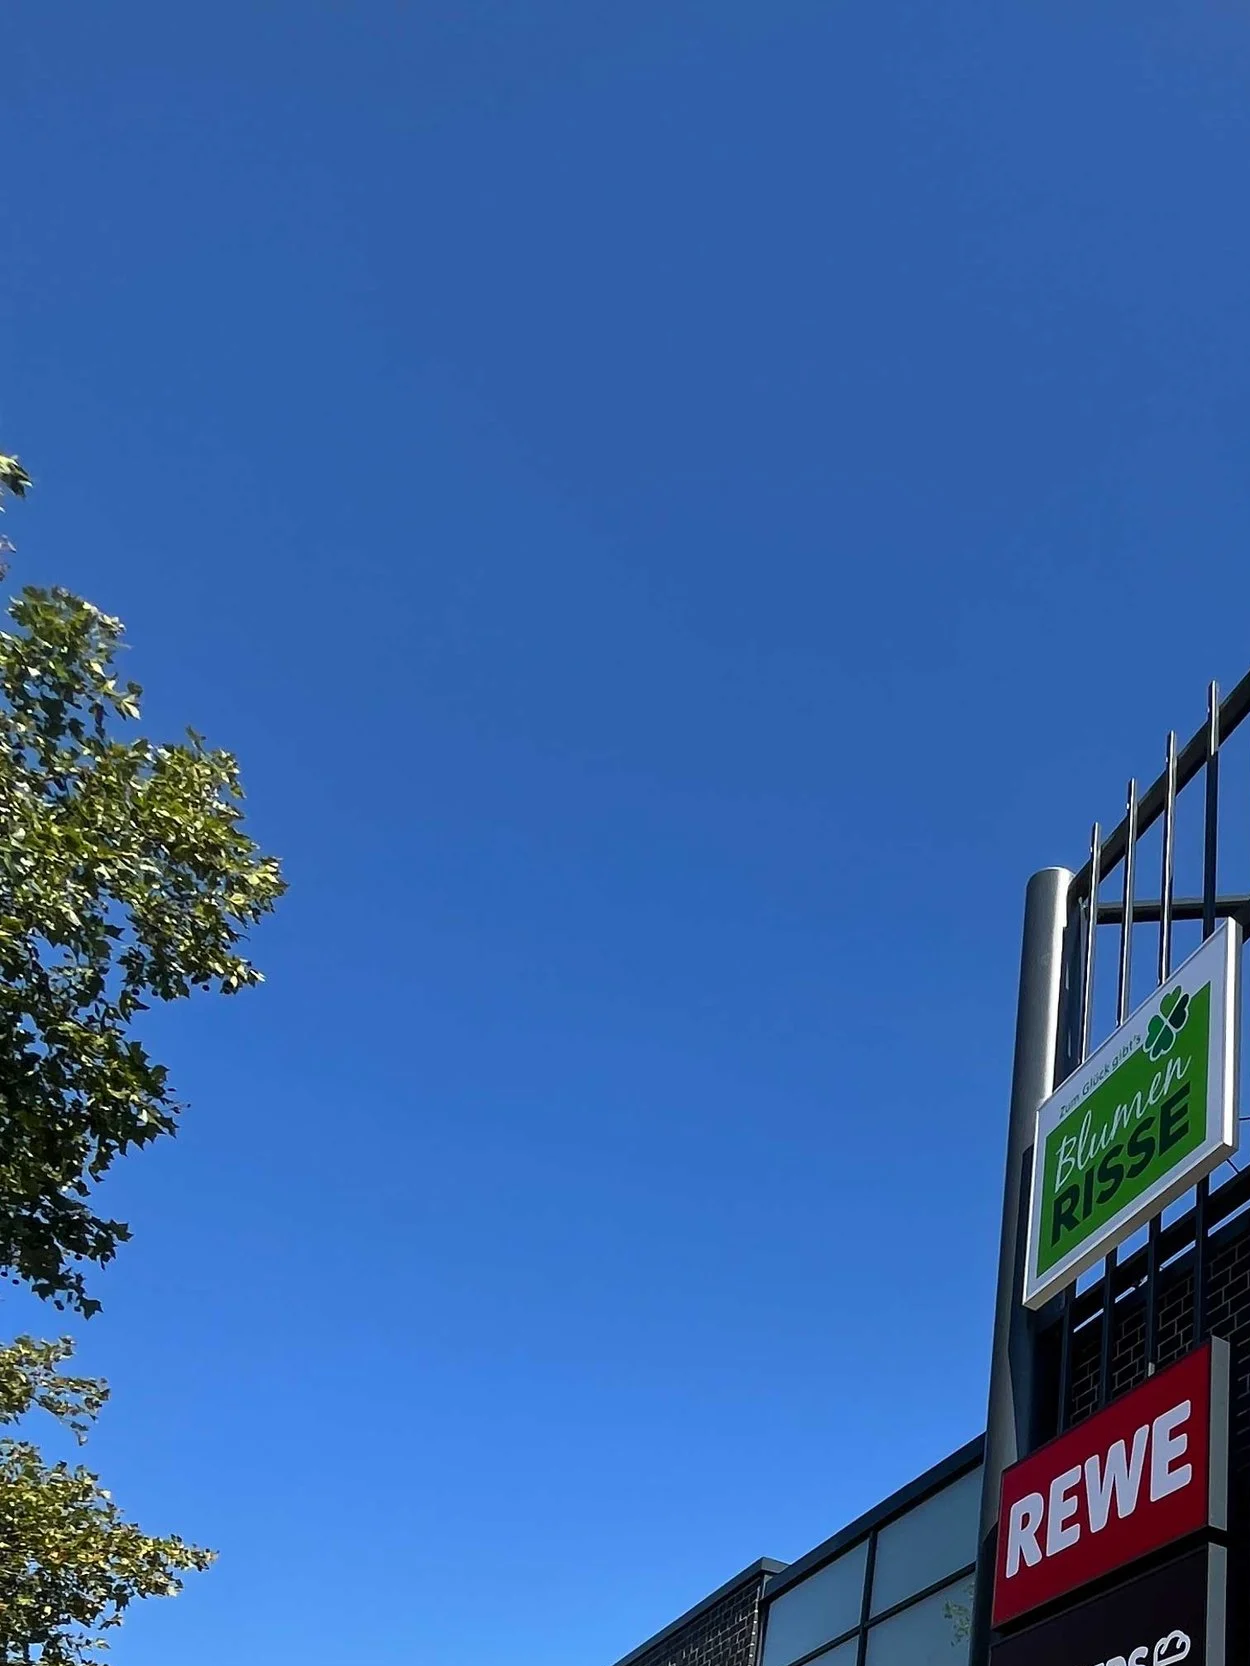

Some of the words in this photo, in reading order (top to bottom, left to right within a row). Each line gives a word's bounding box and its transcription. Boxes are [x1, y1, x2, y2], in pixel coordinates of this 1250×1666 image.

[1050, 1079, 1192, 1248] RISSE
[1054, 1053, 1192, 1194] Blumen
[1058, 1094, 1080, 1119] Zum
[1081, 1063, 1111, 1096] Glück
[1004, 1398, 1193, 1579] REWE
